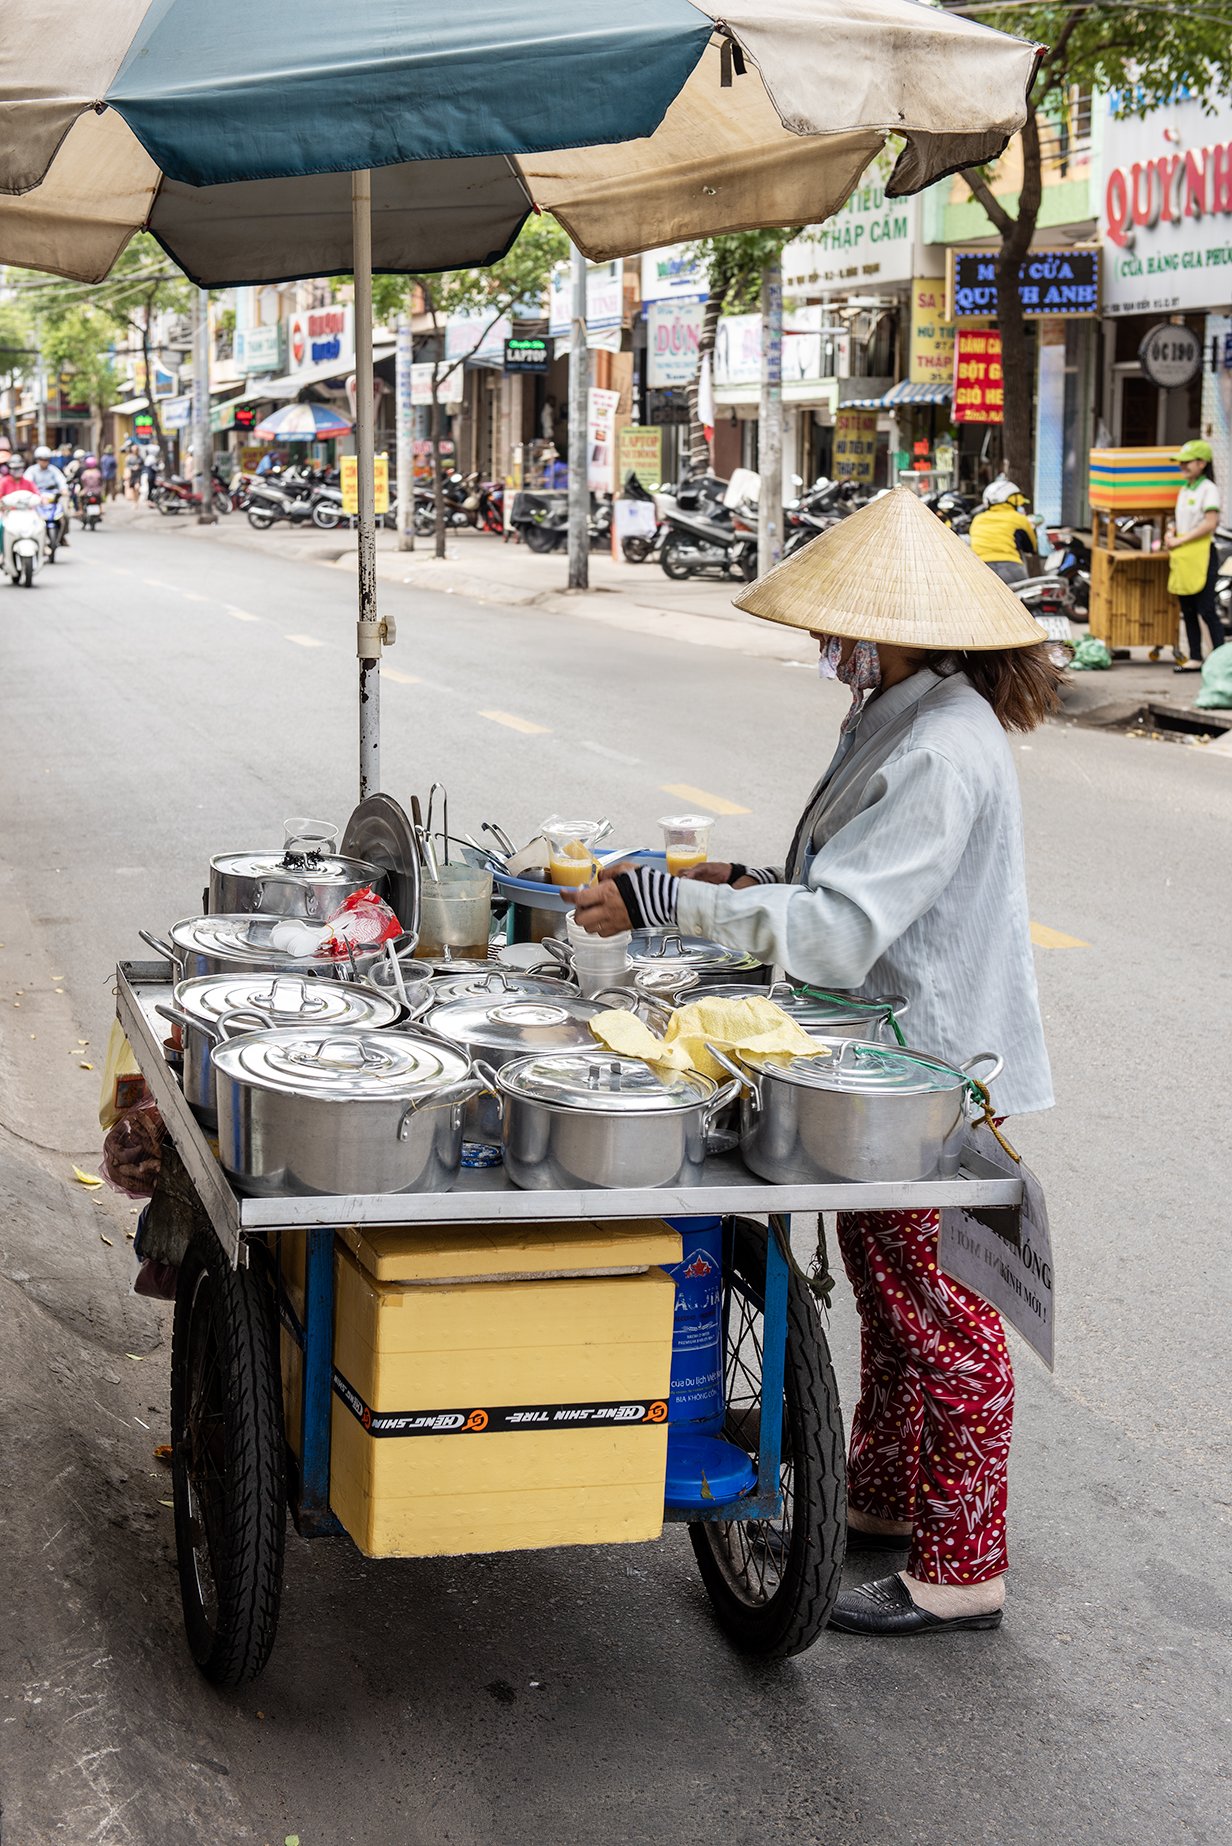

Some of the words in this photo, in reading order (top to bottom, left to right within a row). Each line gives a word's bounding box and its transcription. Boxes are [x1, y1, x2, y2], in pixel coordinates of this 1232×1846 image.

[1043, 284, 1093, 304] ANH
[985, 388, 1004, 405] HE
[409, 1412, 465, 1430] CHENG
[504, 1411, 549, 1423] TIRE
[553, 1408, 595, 1421] SHIN
[591, 1405, 646, 1421] CHENG
[371, 1417, 413, 1430] SHIN
